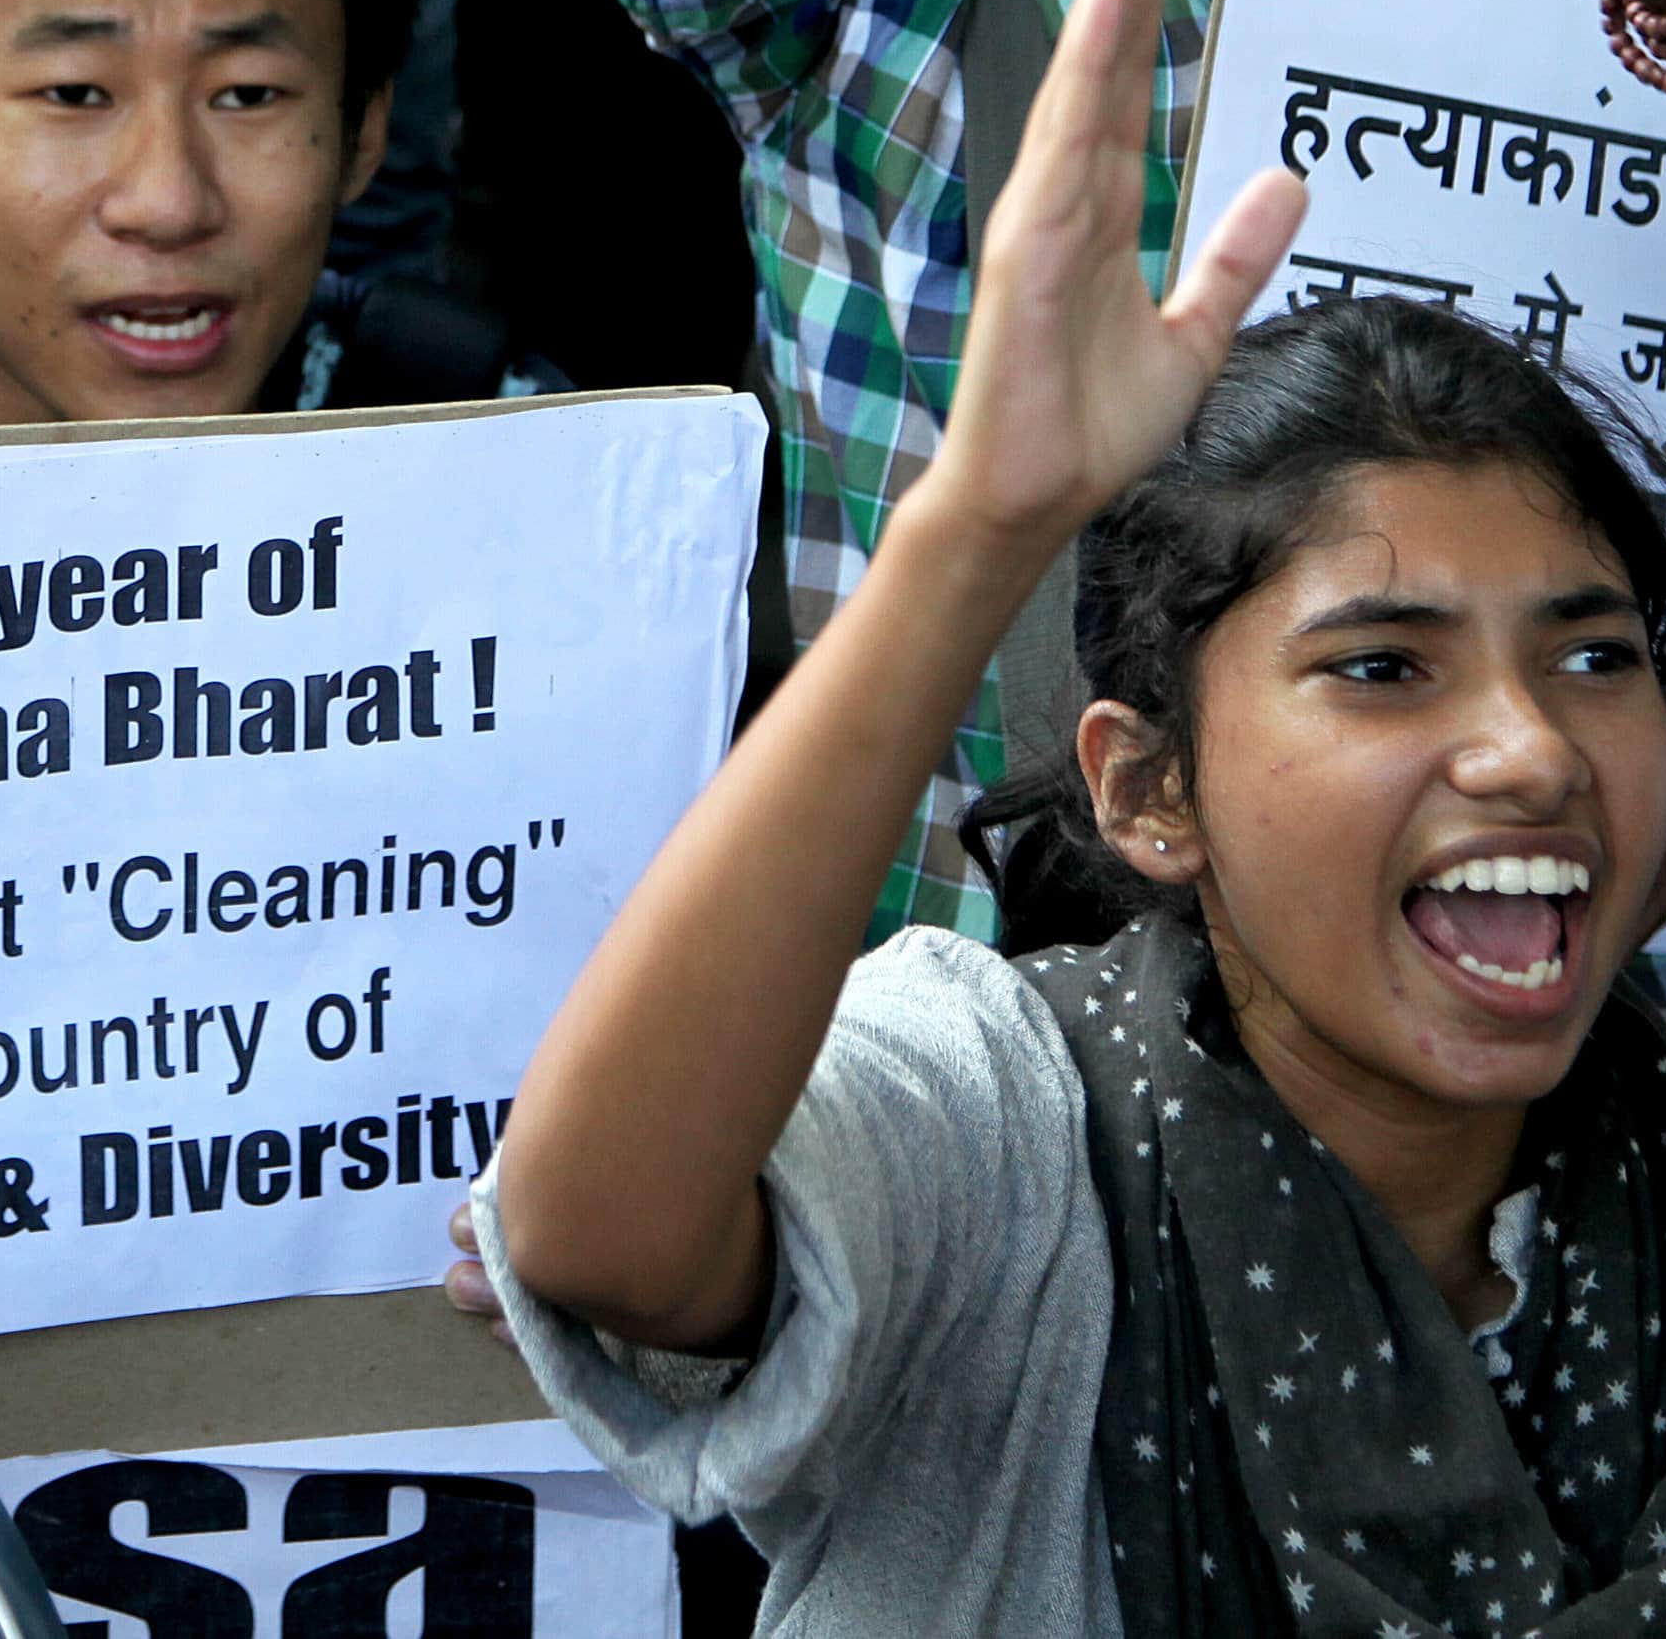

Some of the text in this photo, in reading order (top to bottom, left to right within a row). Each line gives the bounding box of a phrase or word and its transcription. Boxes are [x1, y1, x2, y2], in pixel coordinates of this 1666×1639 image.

[247, 516, 343, 618] of
[104, 648, 440, 763] Bharat
[471, 637, 497, 732] !
[61, 818, 567, 943] "Cleaning"
[305, 967, 392, 1061] of
[81, 1094, 516, 1227] Diversity
